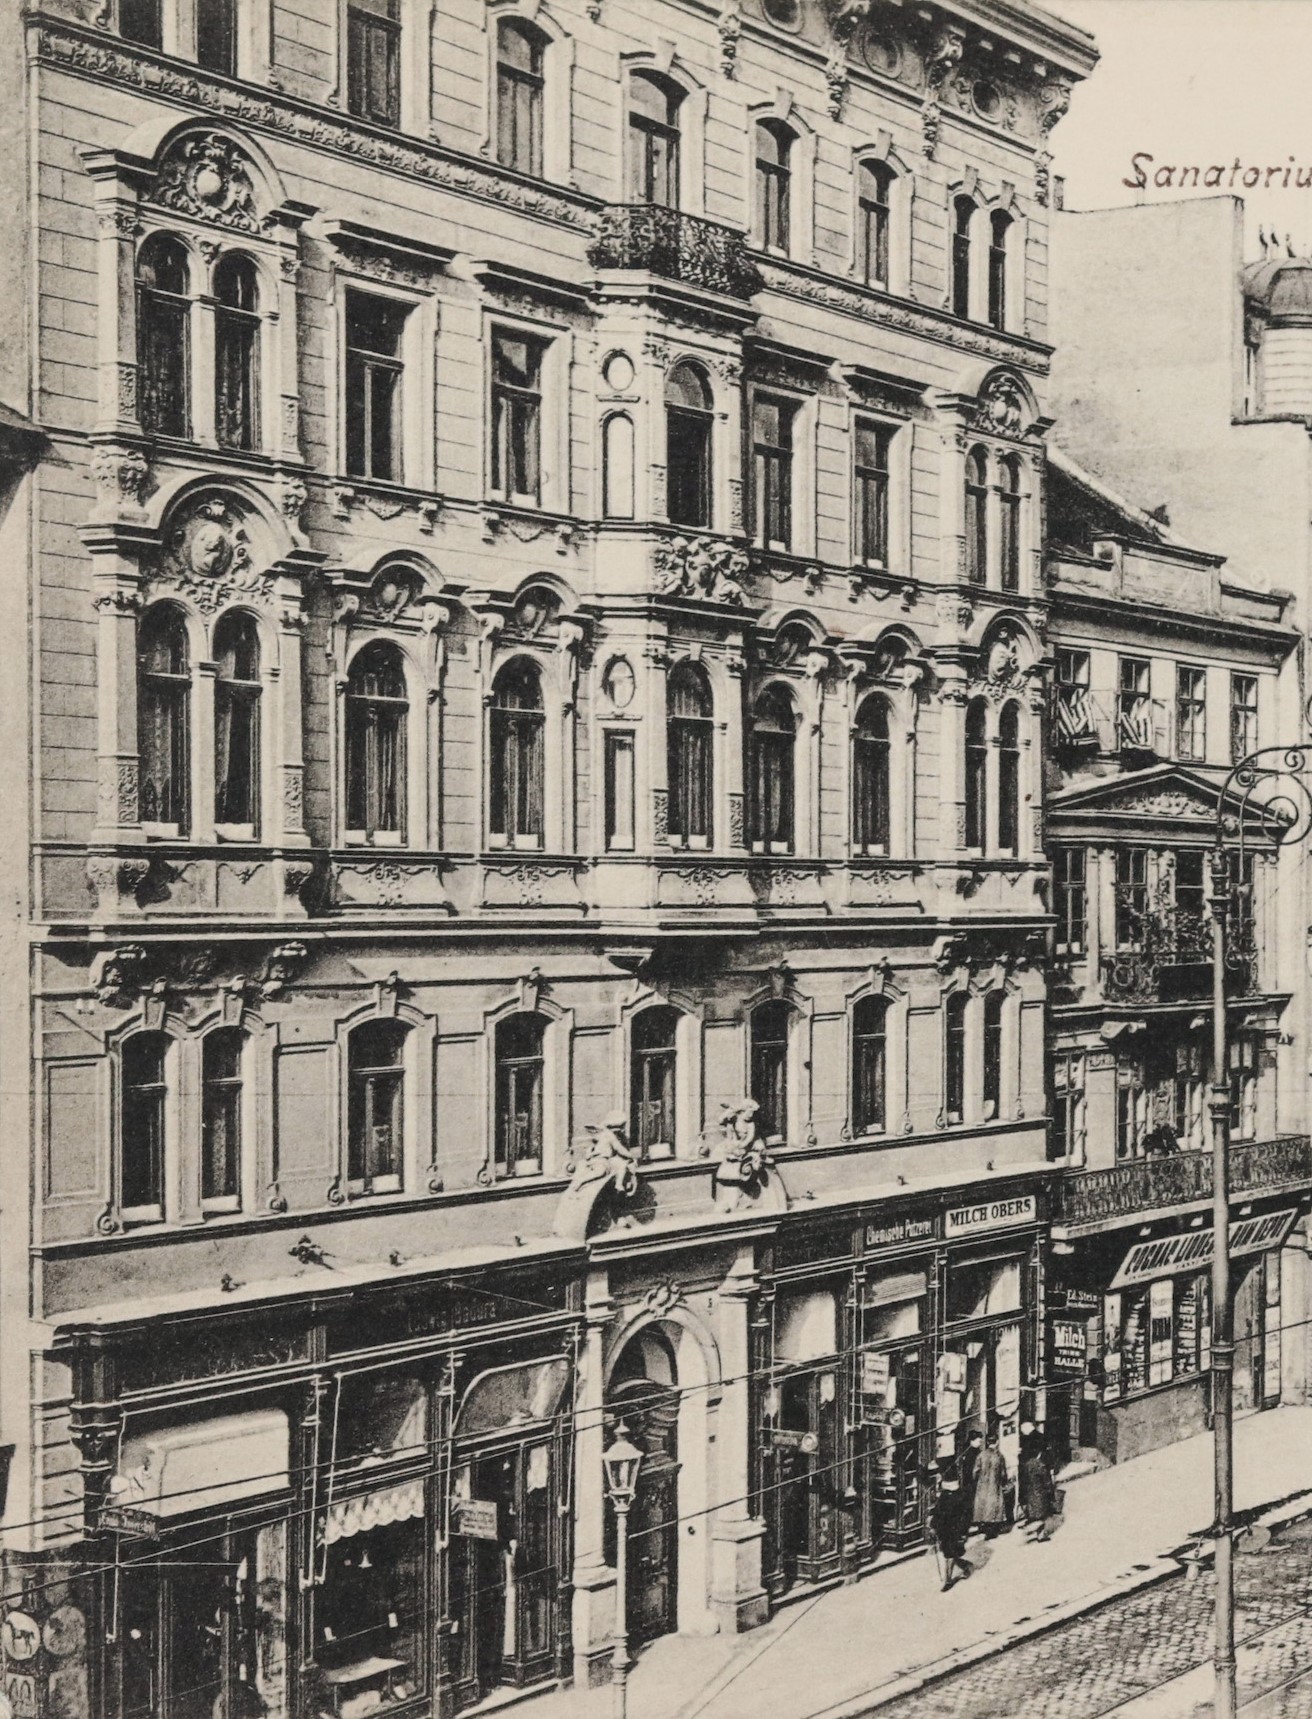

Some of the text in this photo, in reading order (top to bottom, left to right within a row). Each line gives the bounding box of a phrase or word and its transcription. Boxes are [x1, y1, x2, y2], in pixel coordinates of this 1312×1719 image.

[950, 1199, 1033, 1227] MILCH OBERS
[1054, 1326, 1086, 1350] Milch
[1054, 1356, 1085, 1368] HALLE
